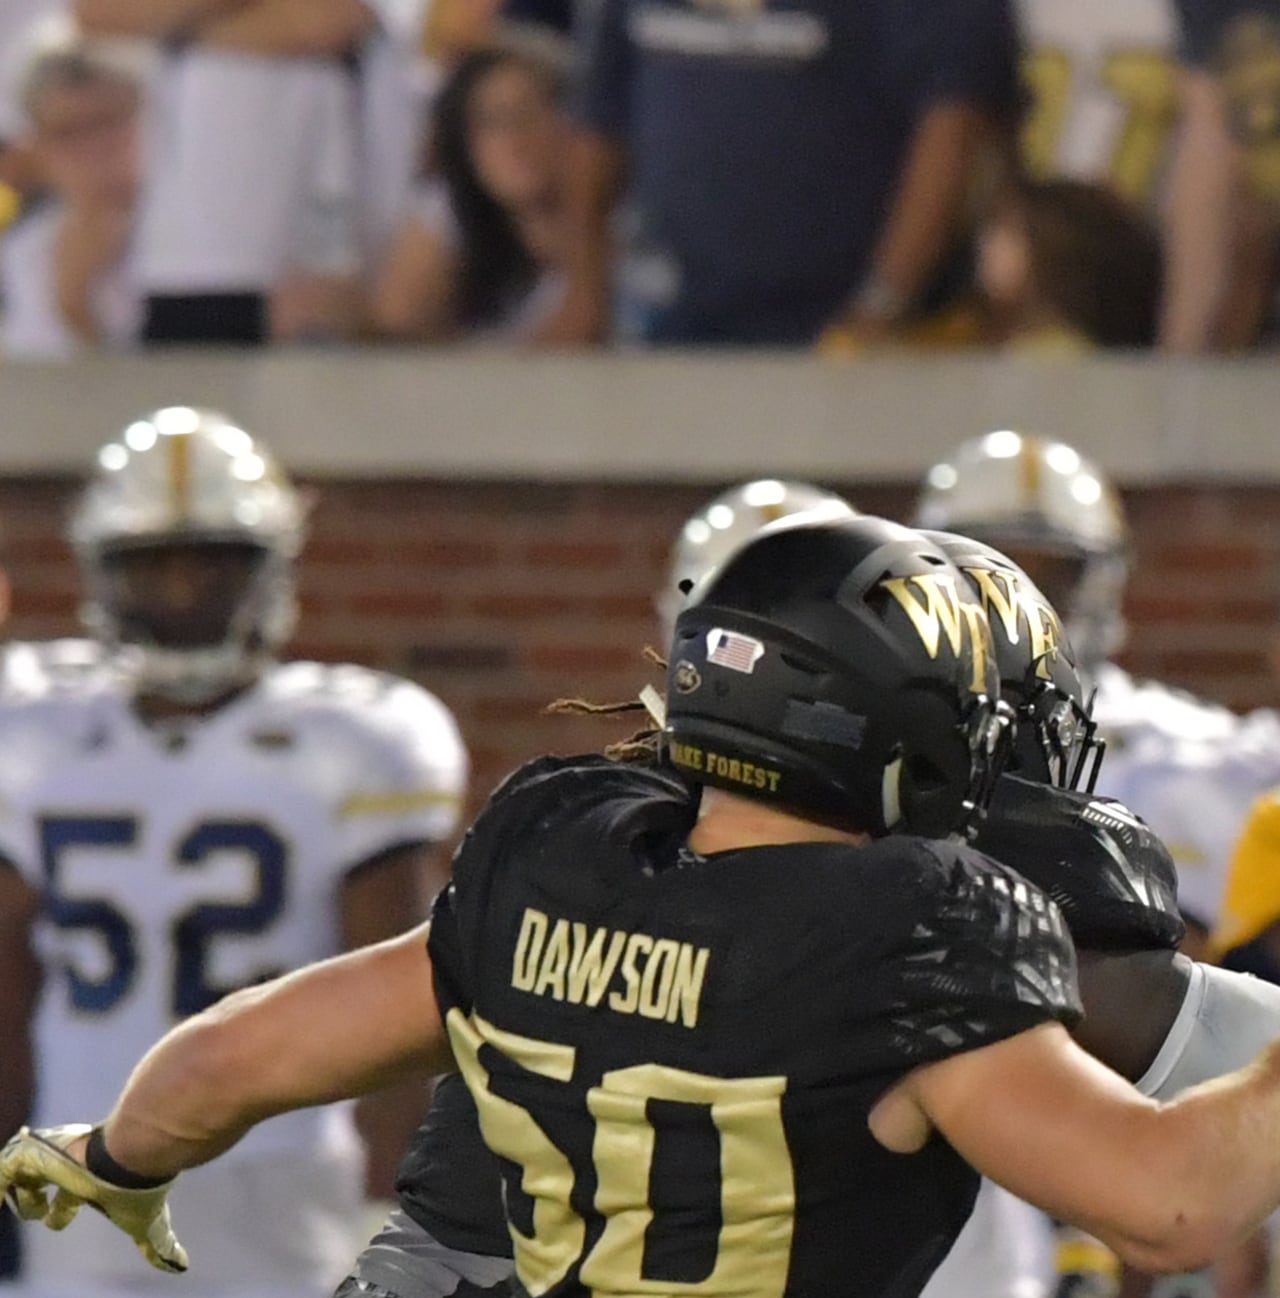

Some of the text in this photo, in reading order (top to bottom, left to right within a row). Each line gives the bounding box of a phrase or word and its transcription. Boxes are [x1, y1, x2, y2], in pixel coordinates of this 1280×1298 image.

[705, 753, 781, 793] FOREST
[37, 812, 290, 1022] 52
[511, 906, 711, 1029] DAWSON
